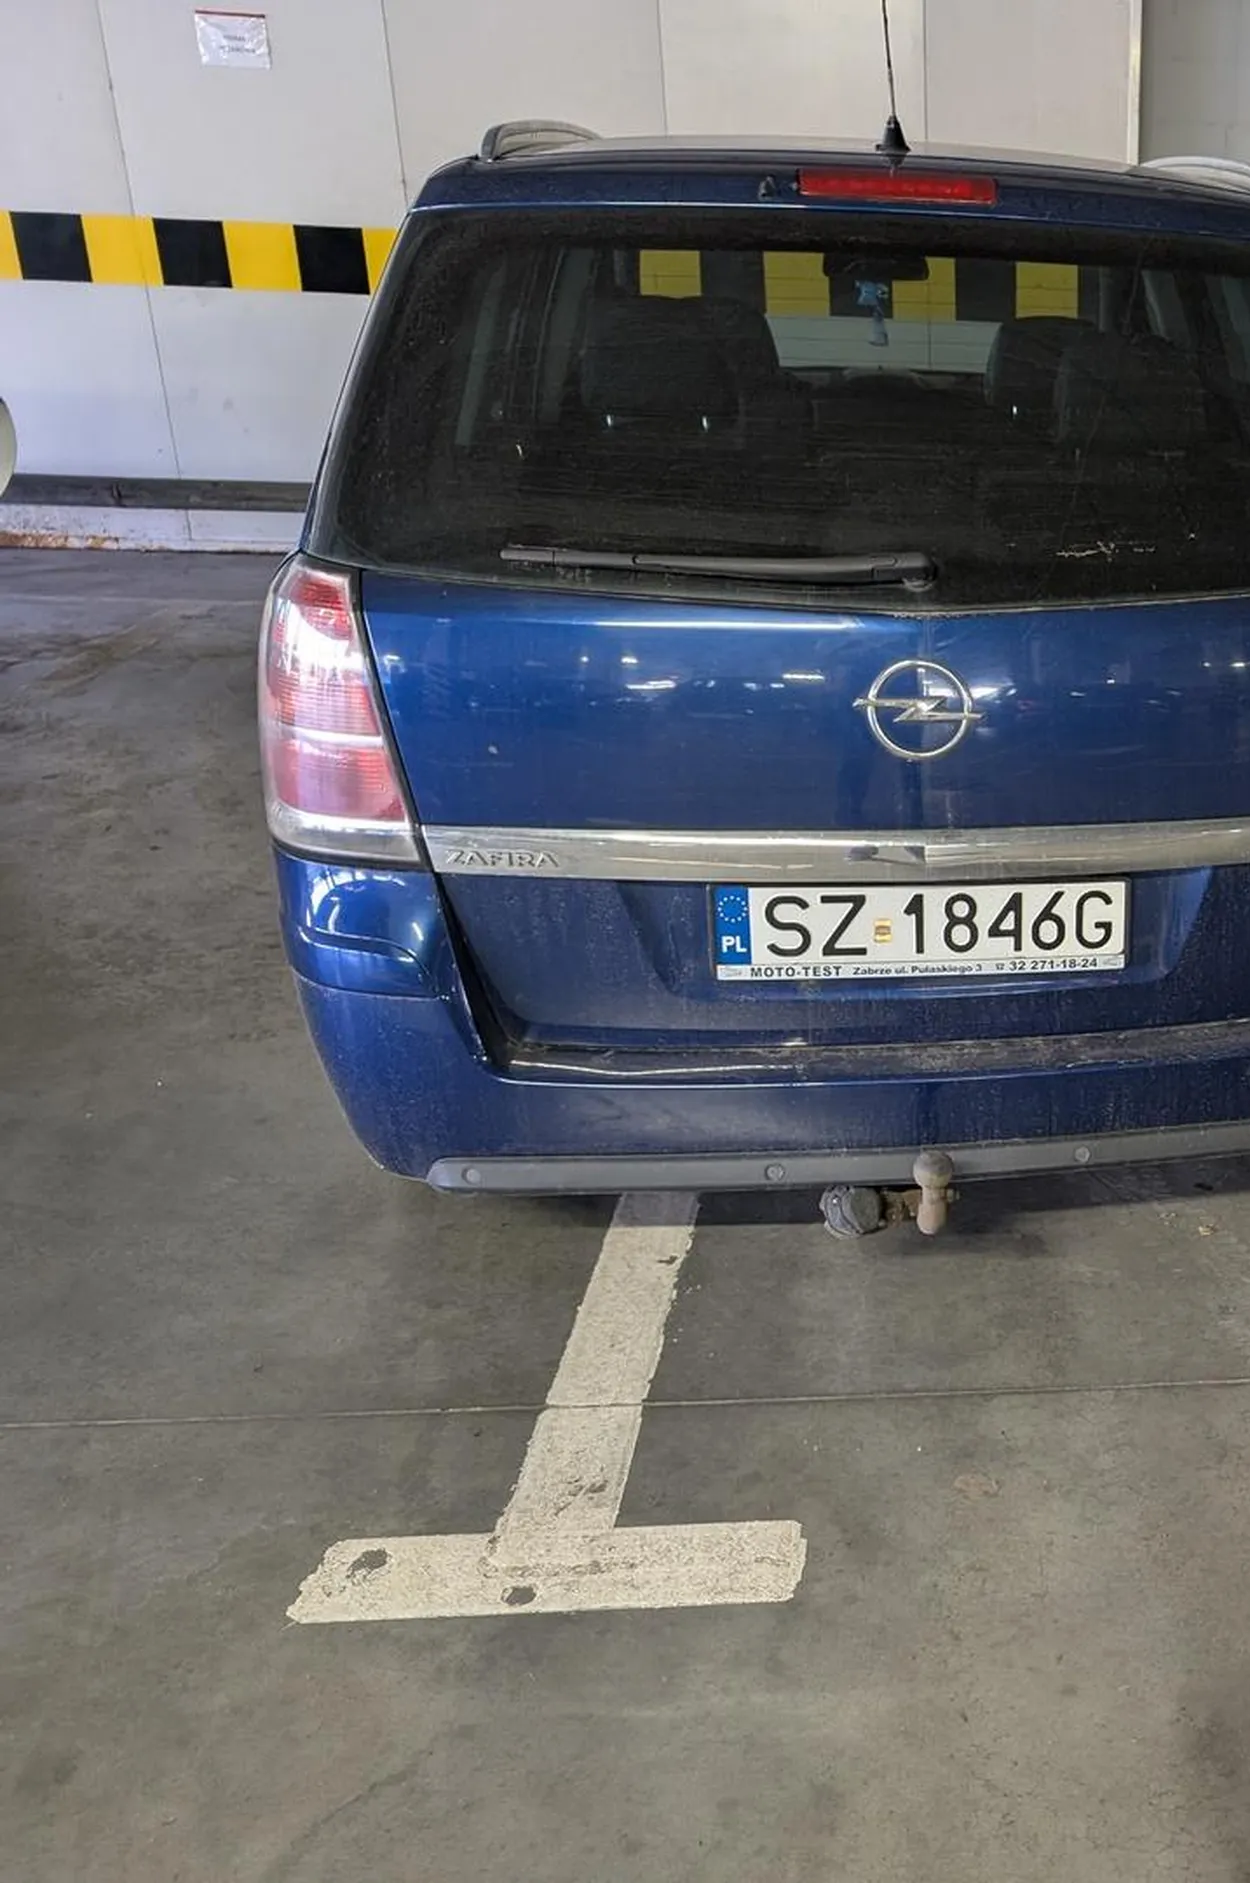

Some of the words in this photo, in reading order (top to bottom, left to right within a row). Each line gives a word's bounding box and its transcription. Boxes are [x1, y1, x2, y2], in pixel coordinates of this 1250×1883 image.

[445, 849, 560, 867] ZAFIRA
[764, 894, 868, 957] SZ
[903, 890, 1113, 954] 1846G
[721, 935, 747, 953] PL
[750, 965, 843, 977] MOTO-TEST
[852, 966, 893, 976] Zabrze
[1009, 960, 1026, 971] 32
[1031, 958, 1098, 970] 271-18-24
